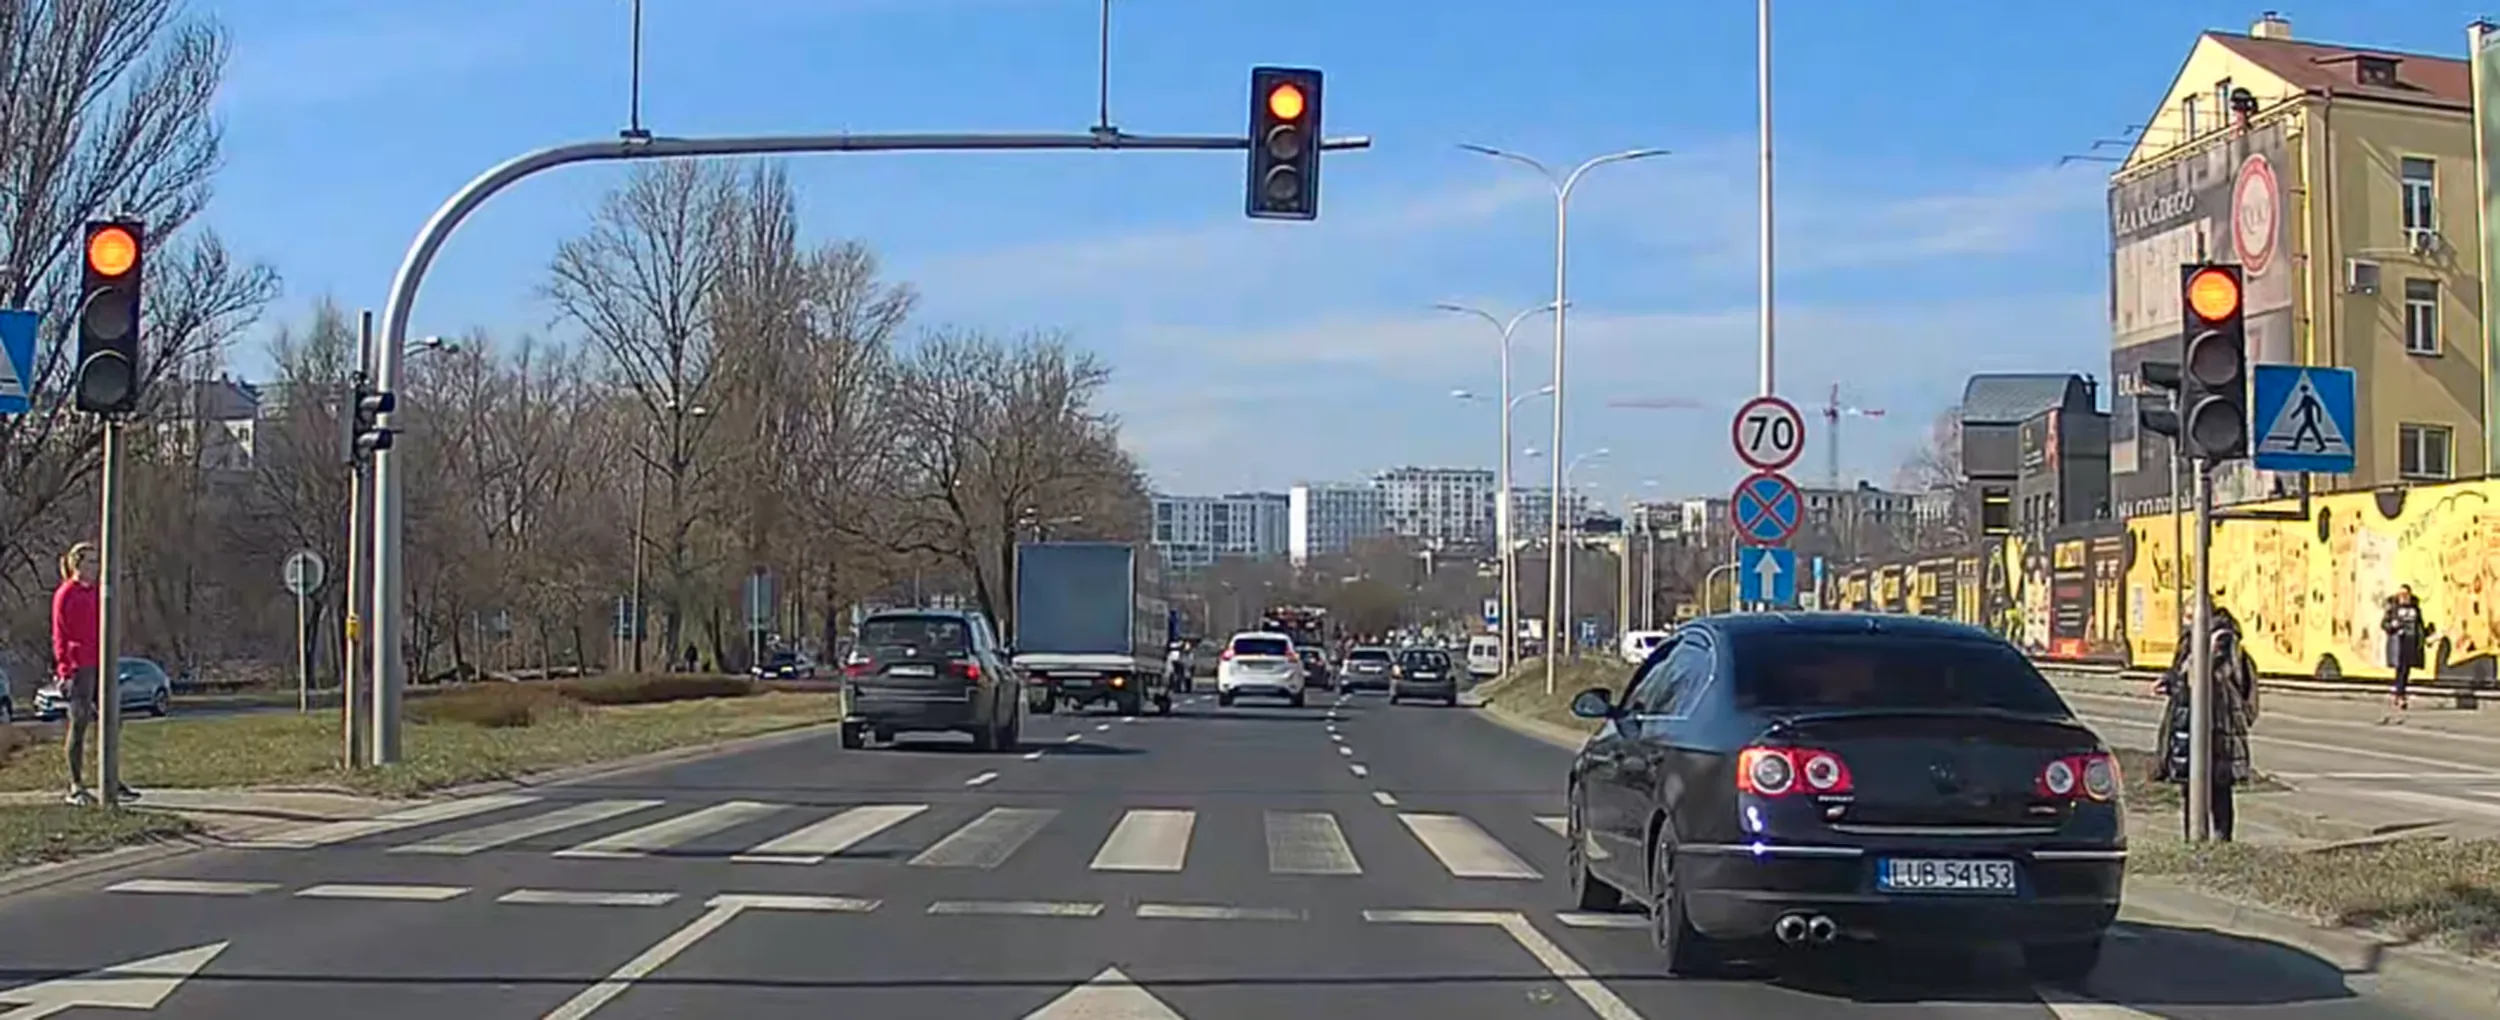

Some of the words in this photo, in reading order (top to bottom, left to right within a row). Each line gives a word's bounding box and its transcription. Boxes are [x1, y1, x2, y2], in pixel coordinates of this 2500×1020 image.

[1747, 416, 1794, 451] 70
[1892, 861, 1937, 886] LUB
[1944, 862, 2012, 888] 54153
